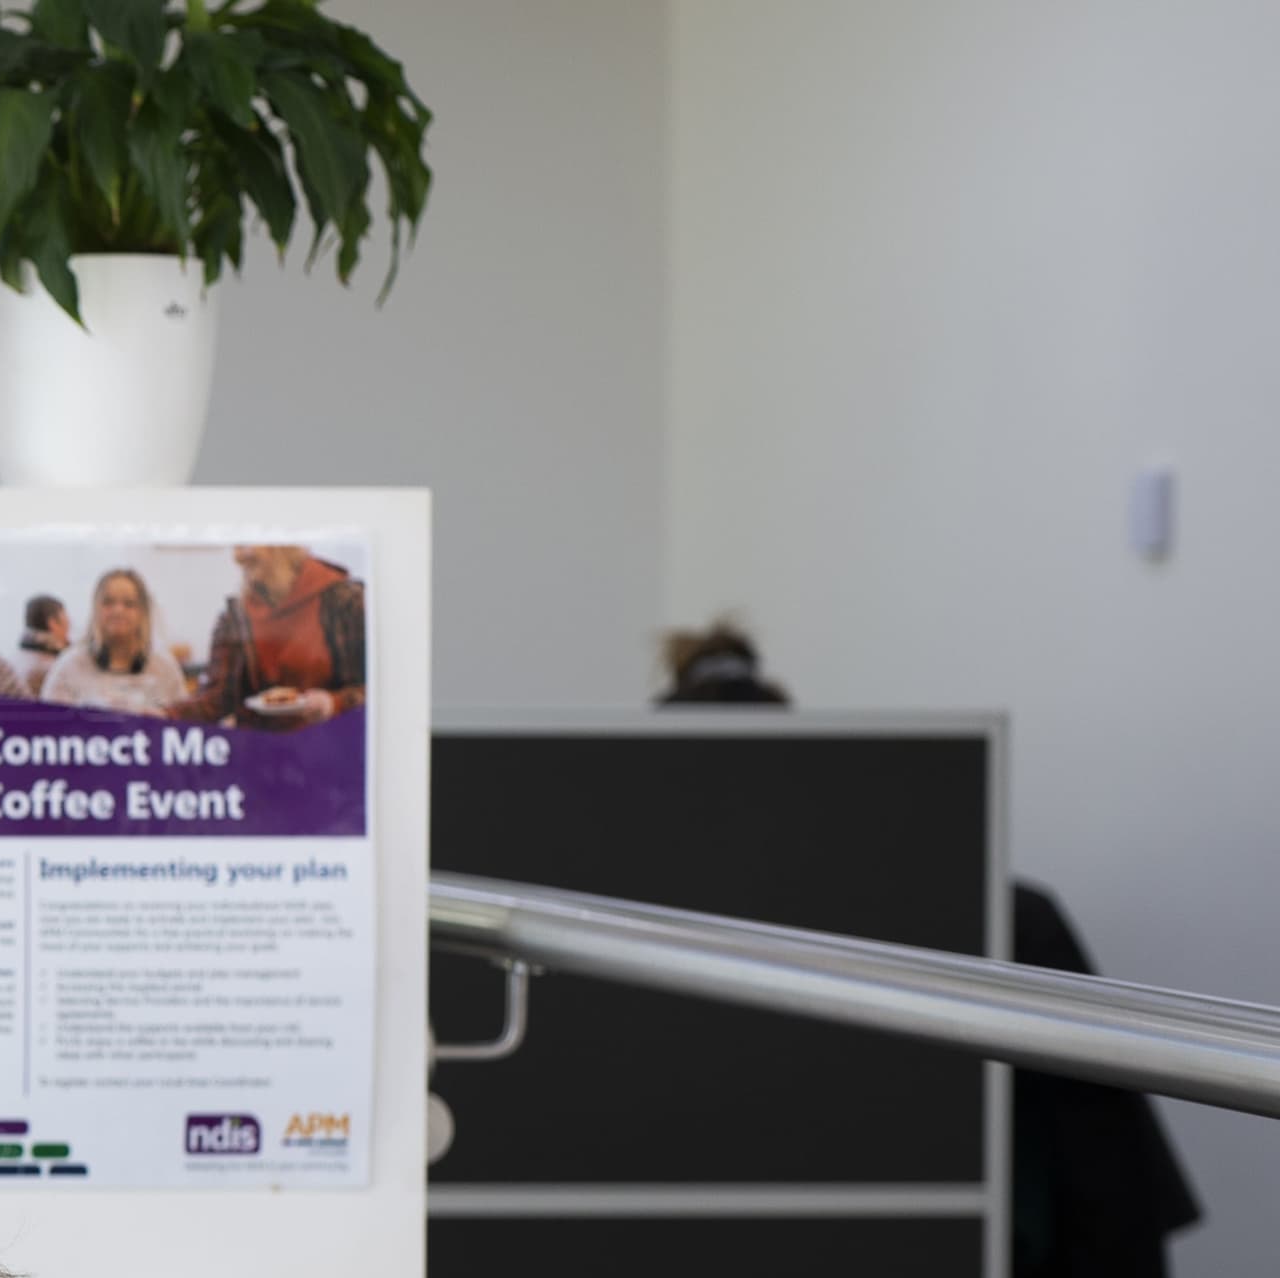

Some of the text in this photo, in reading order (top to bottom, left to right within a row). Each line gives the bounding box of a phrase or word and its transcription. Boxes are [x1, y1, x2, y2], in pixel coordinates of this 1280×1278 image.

[161, 726, 231, 766] Me
[126, 780, 245, 820] Event
[39, 857, 348, 885] Implementing your plan
[190, 1115, 257, 1151] ndis
[283, 1113, 350, 1139] APM
